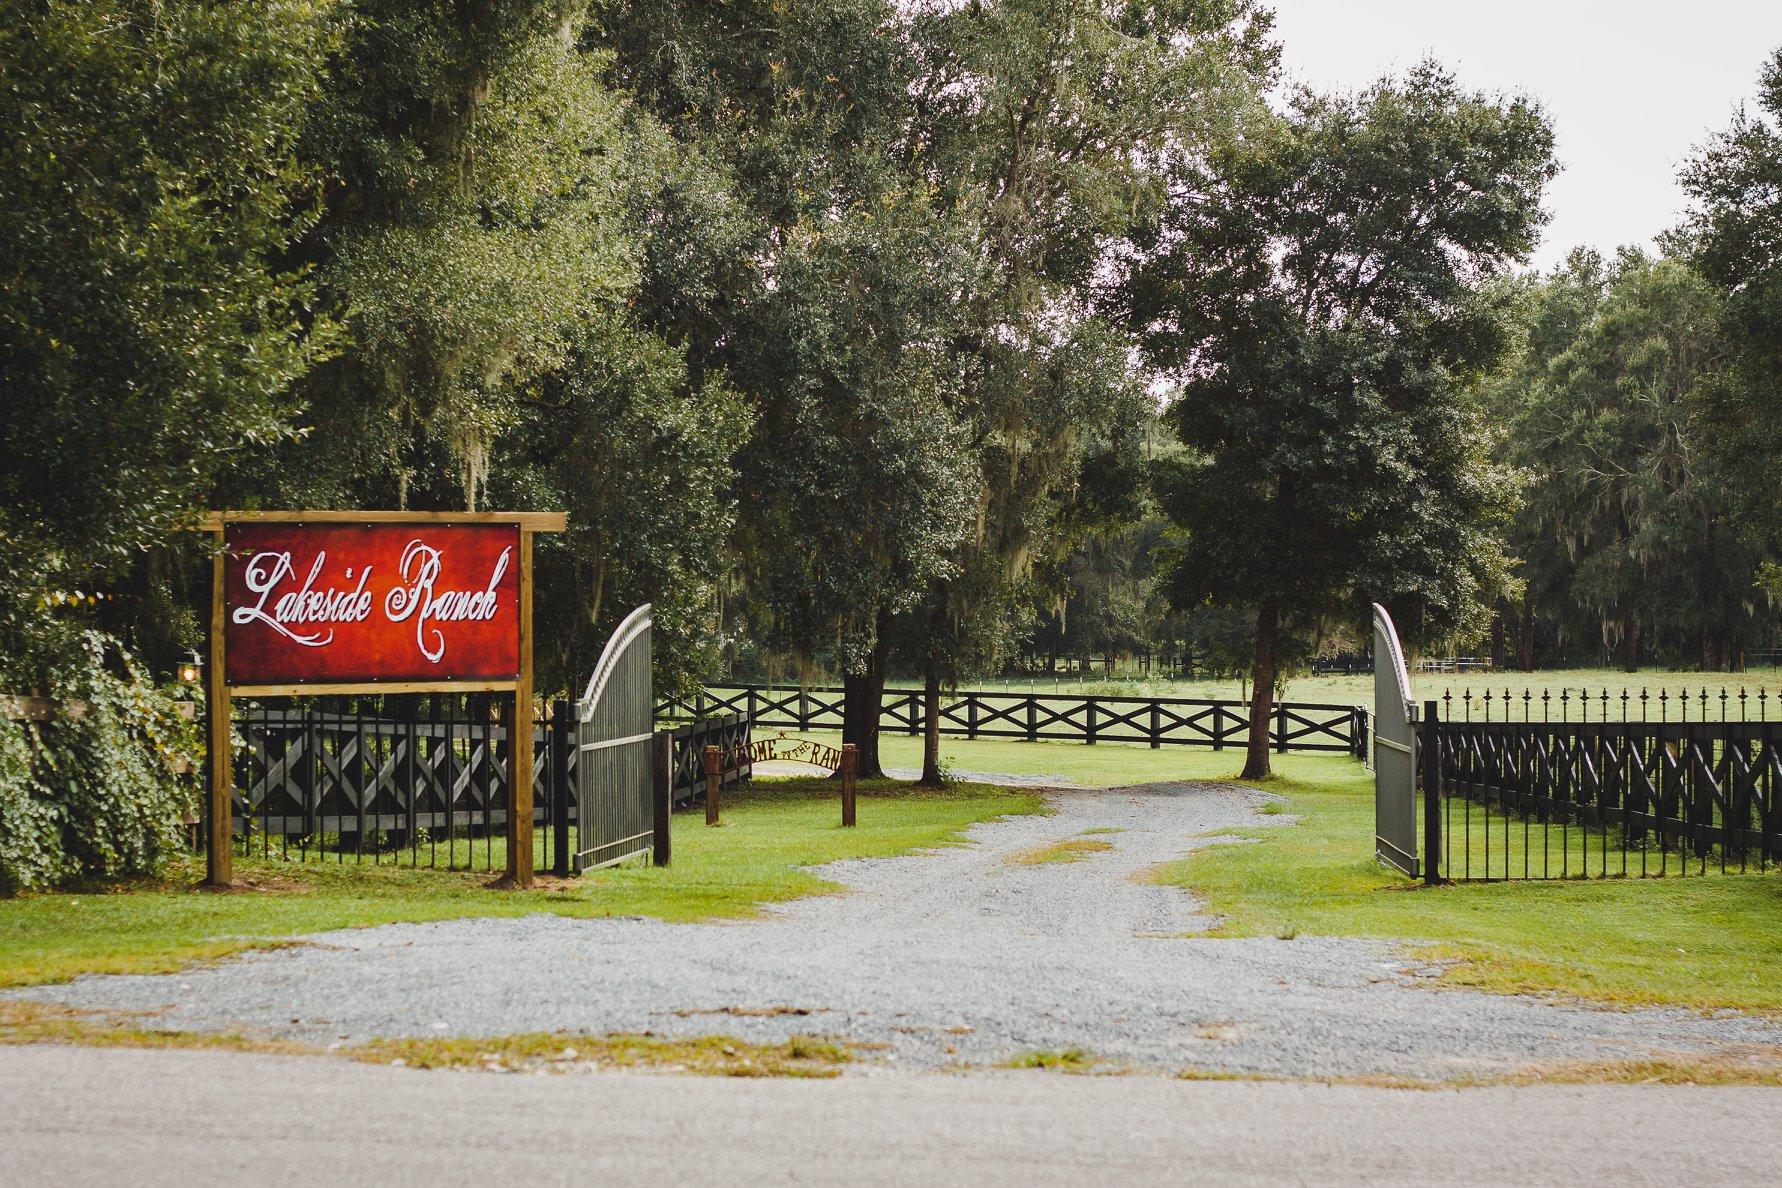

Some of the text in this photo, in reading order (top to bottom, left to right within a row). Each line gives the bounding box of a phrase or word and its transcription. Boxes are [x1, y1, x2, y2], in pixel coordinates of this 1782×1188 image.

[232, 538, 513, 664] Lakeside Ranch
[792, 740, 811, 758] THE
